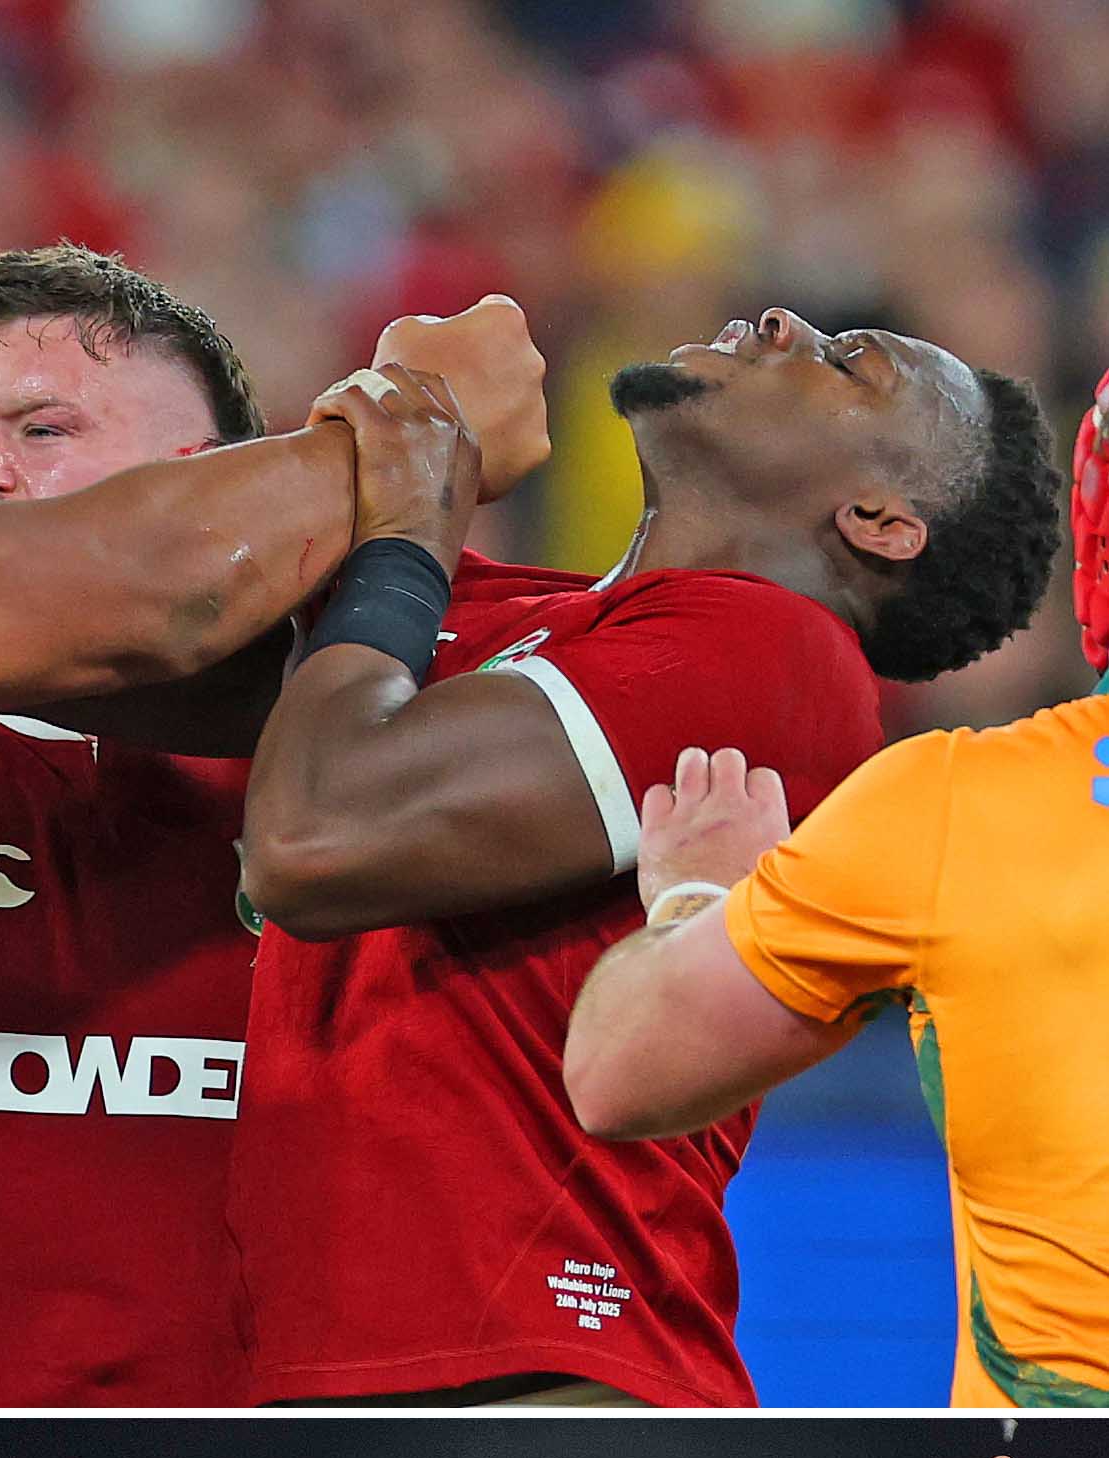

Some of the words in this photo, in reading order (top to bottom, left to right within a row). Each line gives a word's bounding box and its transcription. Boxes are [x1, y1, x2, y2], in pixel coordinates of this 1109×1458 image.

[564, 1259, 591, 1275] Maro
[592, 1262, 616, 1281] Itoje
[547, 1275, 593, 1294] Wallabies
[594, 1284, 601, 1296] v
[602, 1282, 631, 1300] Lions
[555, 1293, 578, 1309] 26th
[578, 1296, 597, 1315] July
[597, 1300, 621, 1317] 2025
